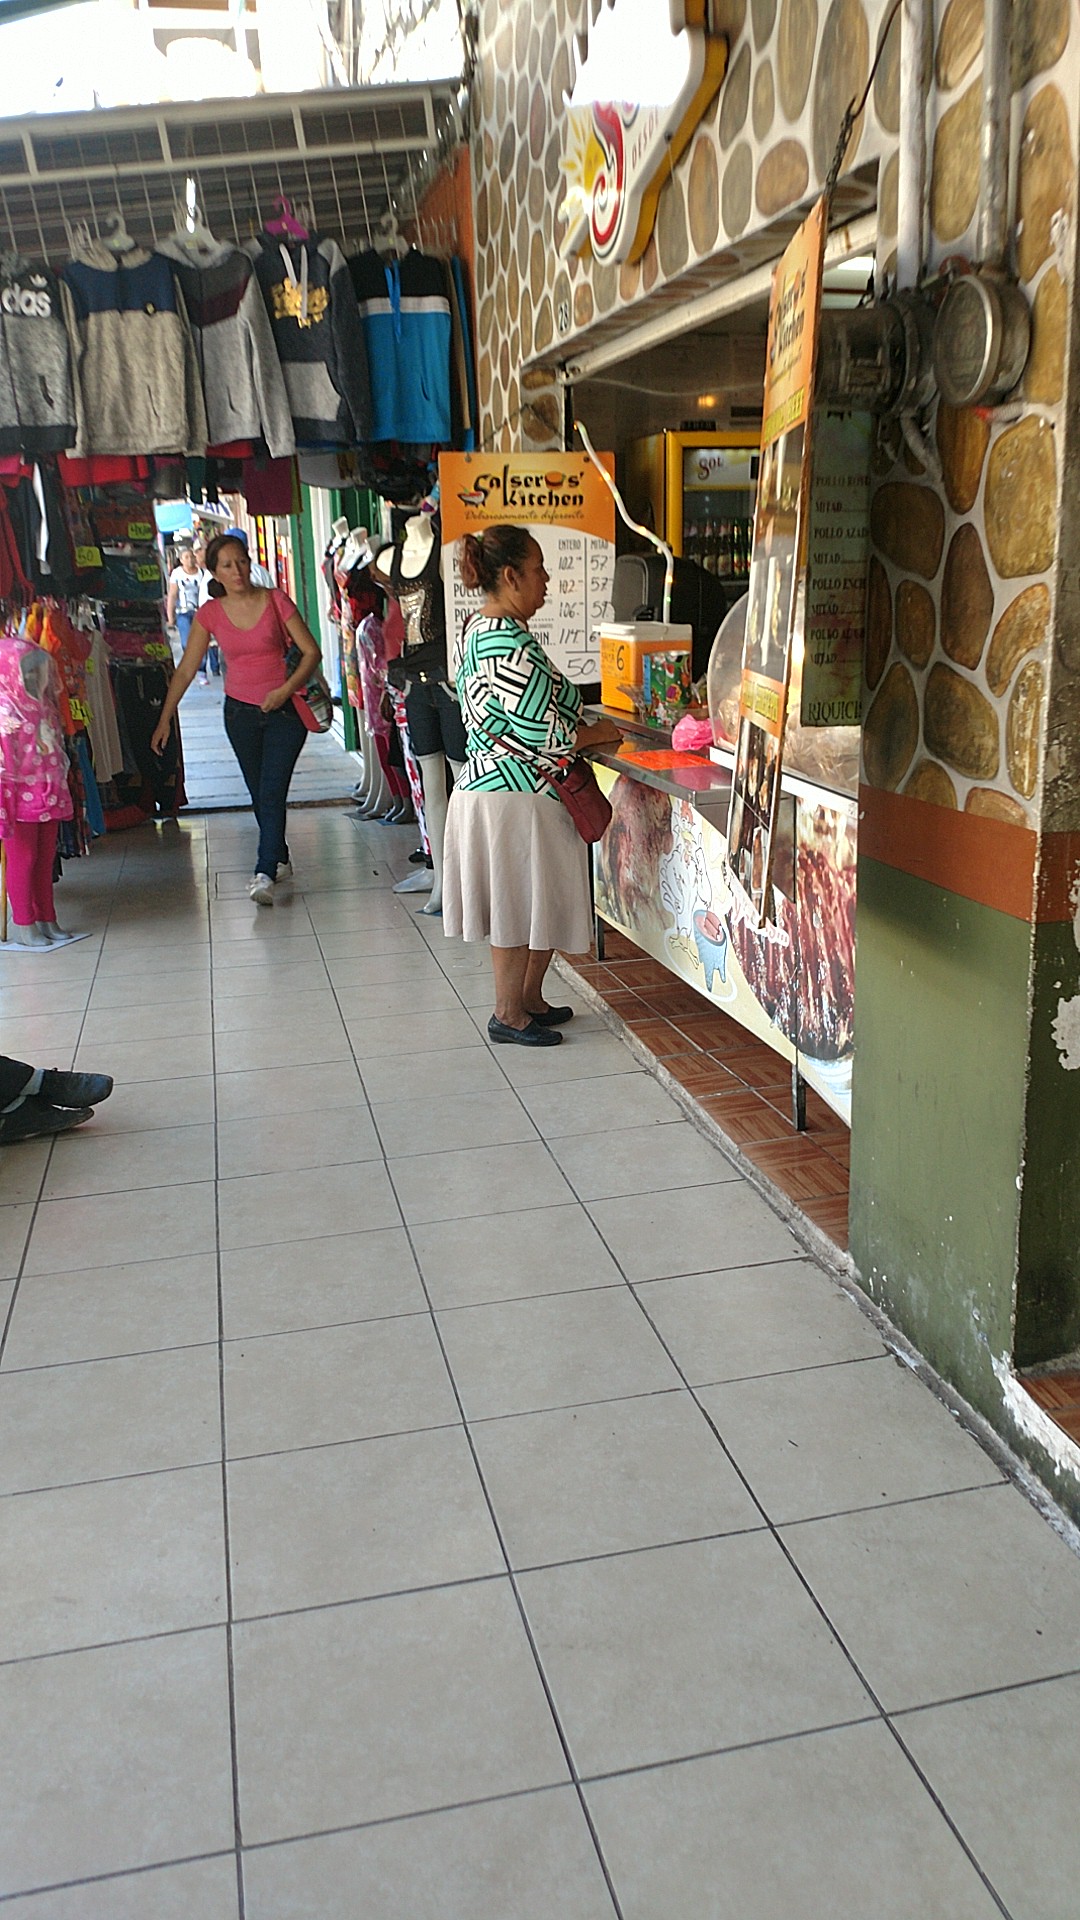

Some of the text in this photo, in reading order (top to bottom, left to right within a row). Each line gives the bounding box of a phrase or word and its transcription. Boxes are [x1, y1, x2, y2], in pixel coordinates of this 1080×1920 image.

[559, 302, 568, 331] 28
[503, 487, 583, 507] Kitchen
[815, 502, 842, 512] MITAD
[814, 527, 842, 539] POLLO
[558, 538, 581, 551] ENTERO
[813, 553, 840, 564] MITAD
[812, 579, 841, 590] POLLO
[811, 629, 838, 640] POLLO
[617, 645, 624, 671] 6
